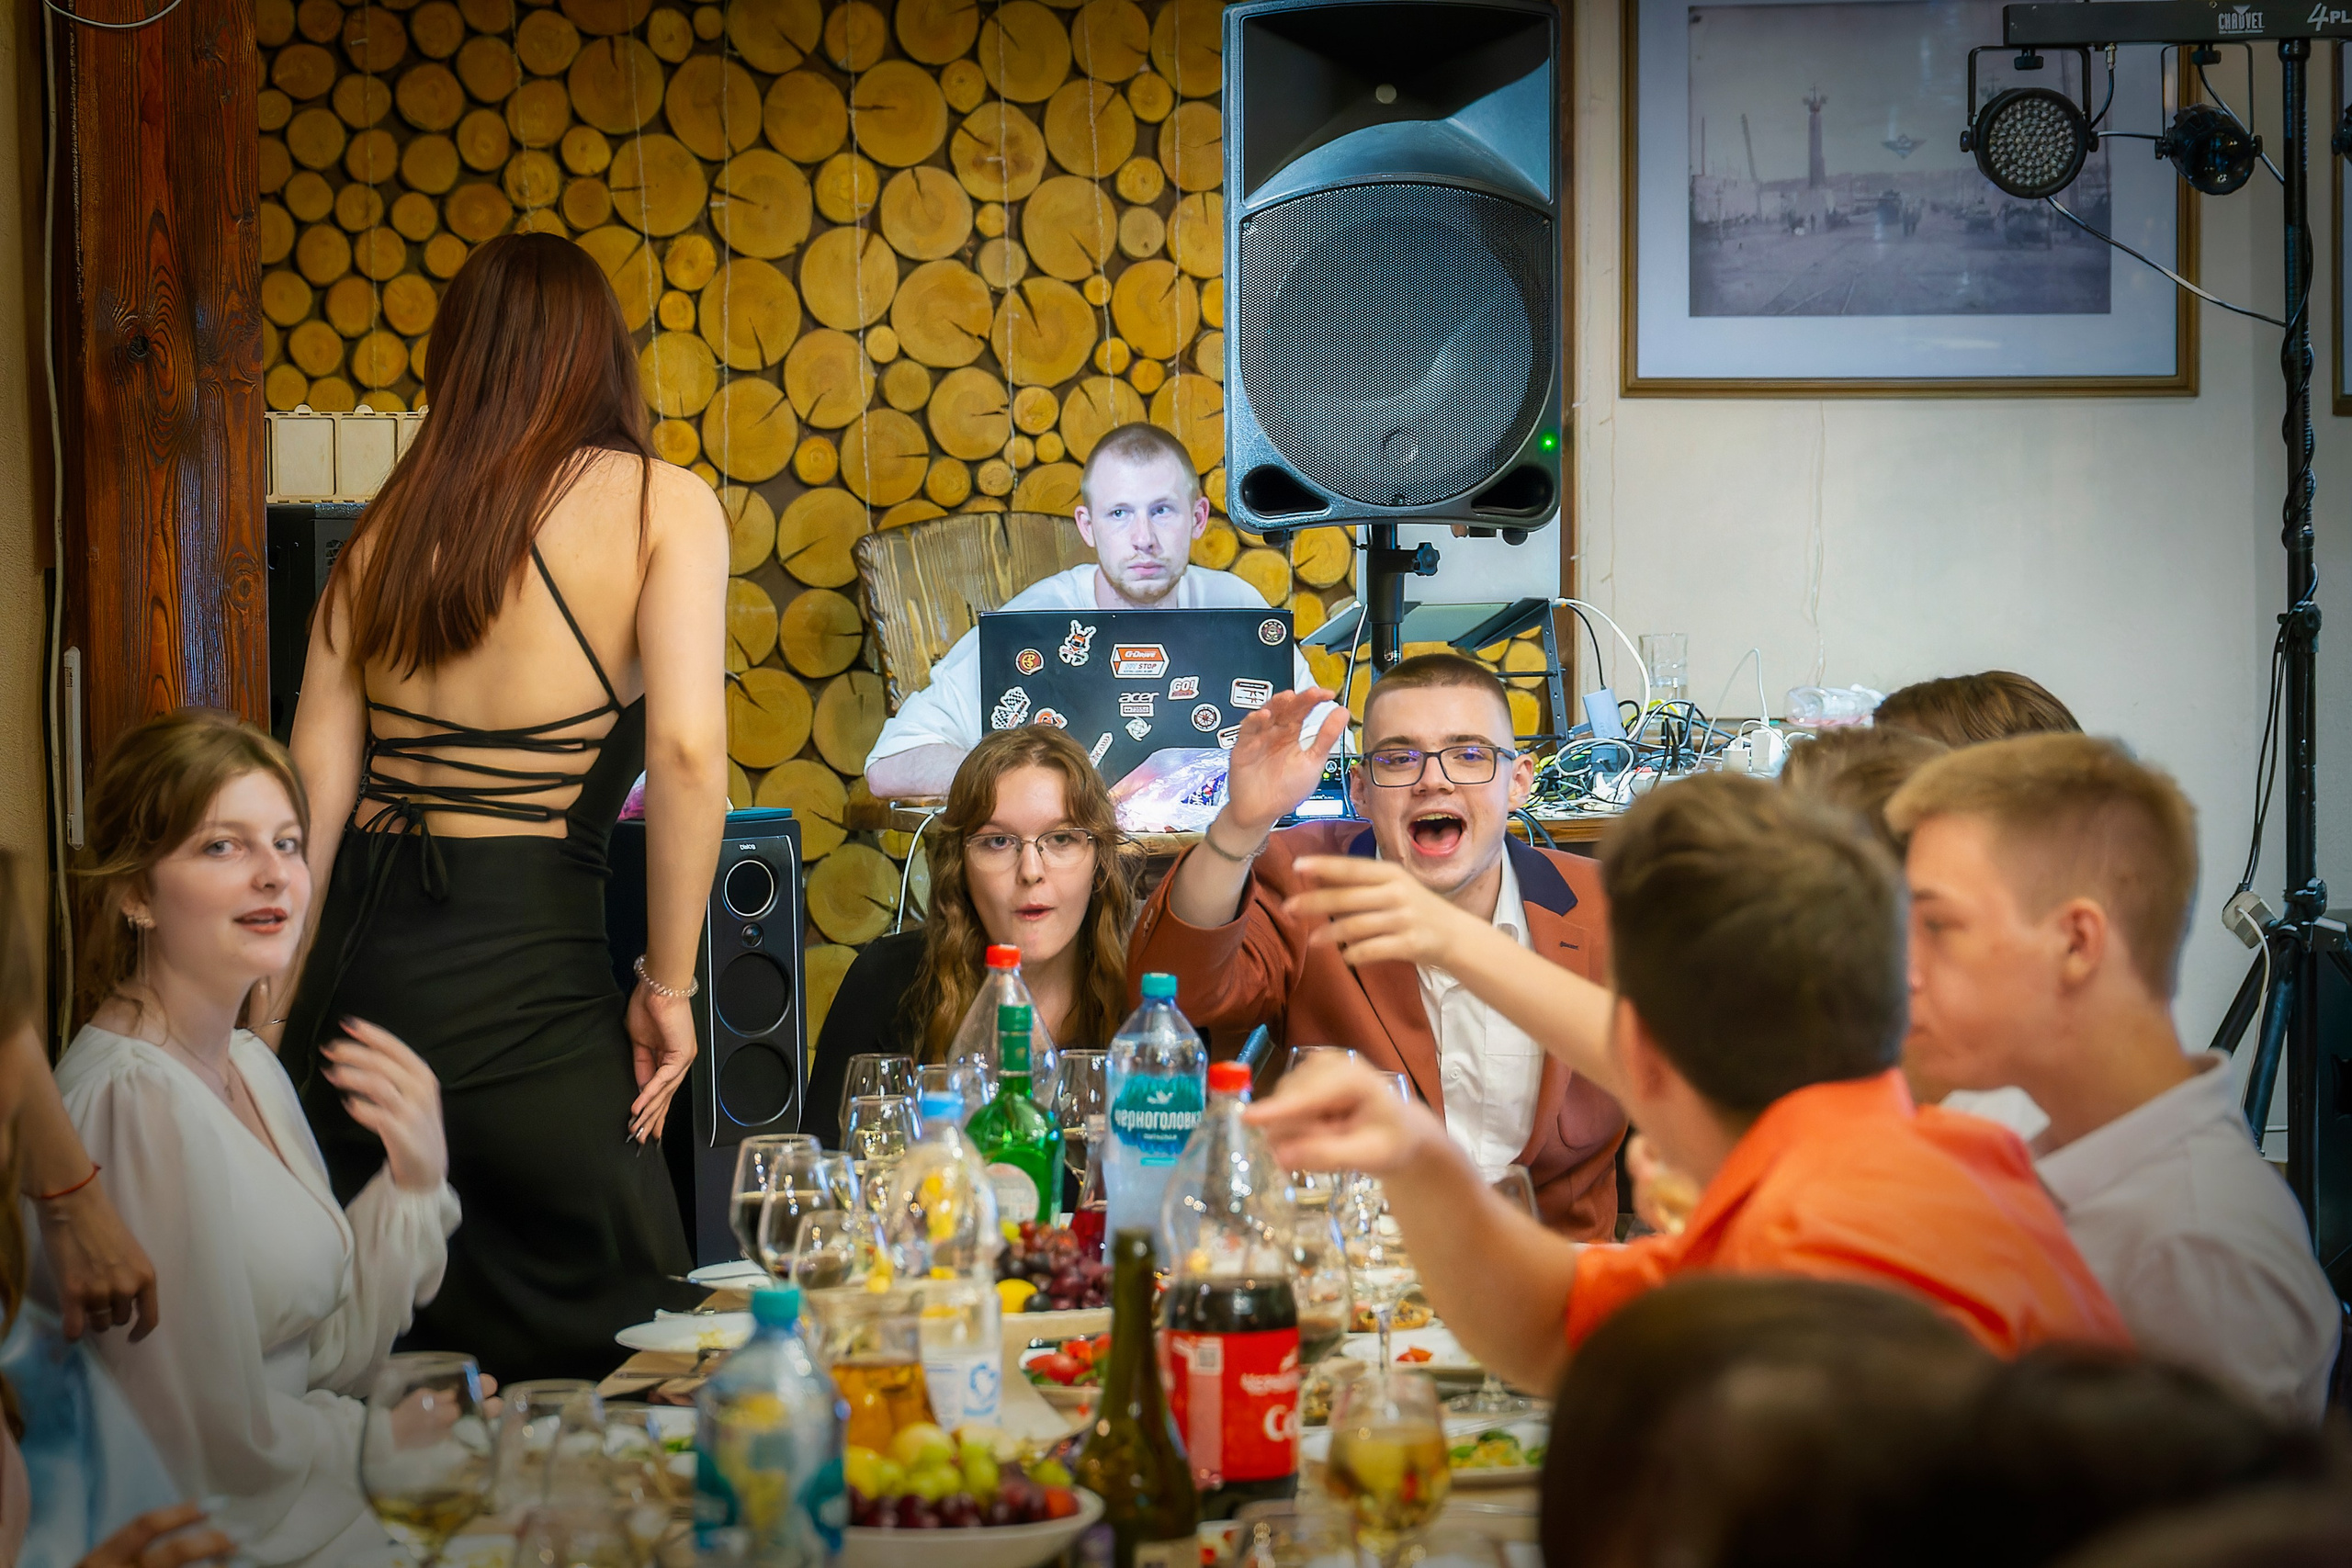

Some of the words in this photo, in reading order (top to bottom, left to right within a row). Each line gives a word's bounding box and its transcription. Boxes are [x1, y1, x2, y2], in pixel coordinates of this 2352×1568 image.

[2218, 12, 2266, 30] CHAUVET
[1172, 680, 1195, 692] GO!
[1118, 692, 1159, 703] acer
